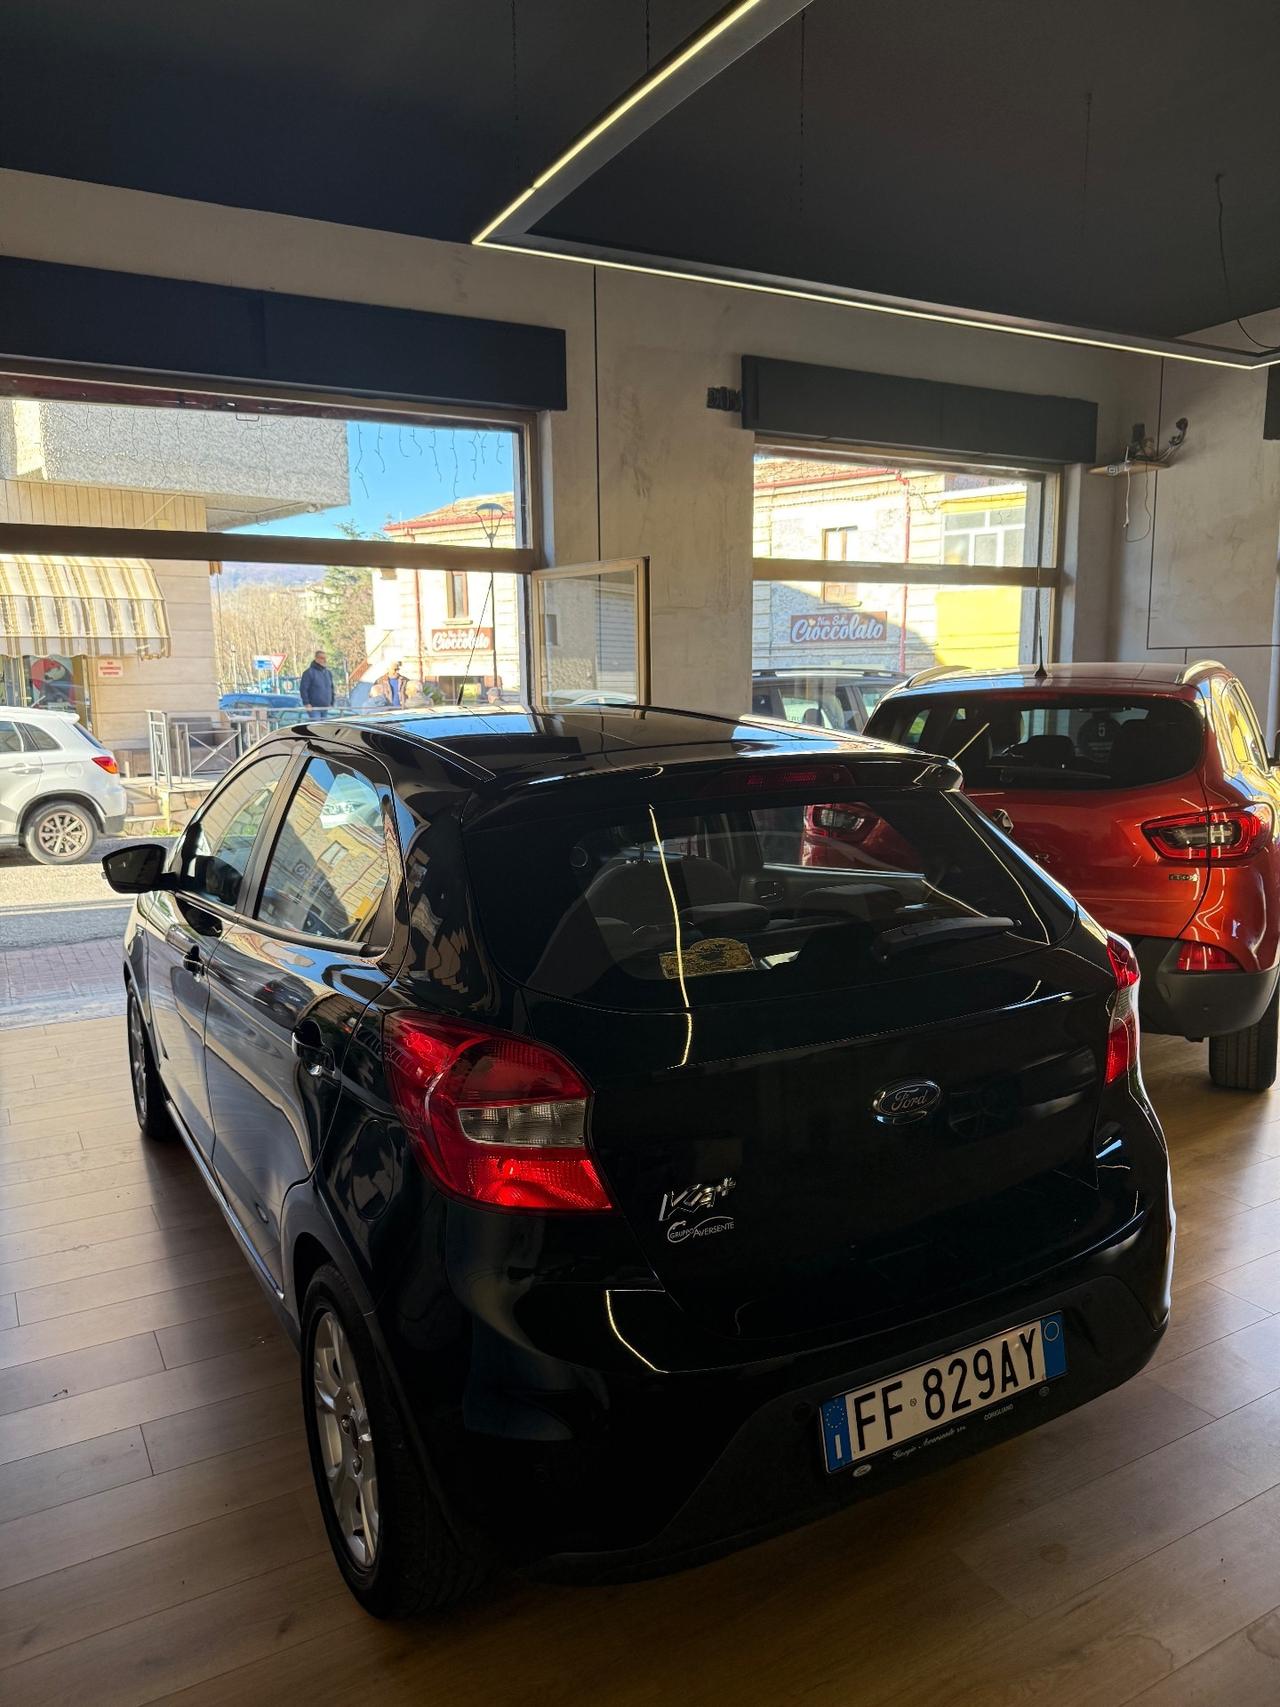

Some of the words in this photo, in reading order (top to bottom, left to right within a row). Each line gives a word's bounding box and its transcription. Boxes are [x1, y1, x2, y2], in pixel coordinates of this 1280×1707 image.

[791, 614, 884, 643] Cioccolato
[891, 1087, 928, 1111] Ford
[853, 1381, 903, 1452] FF
[922, 1327, 1037, 1421] 829AY
